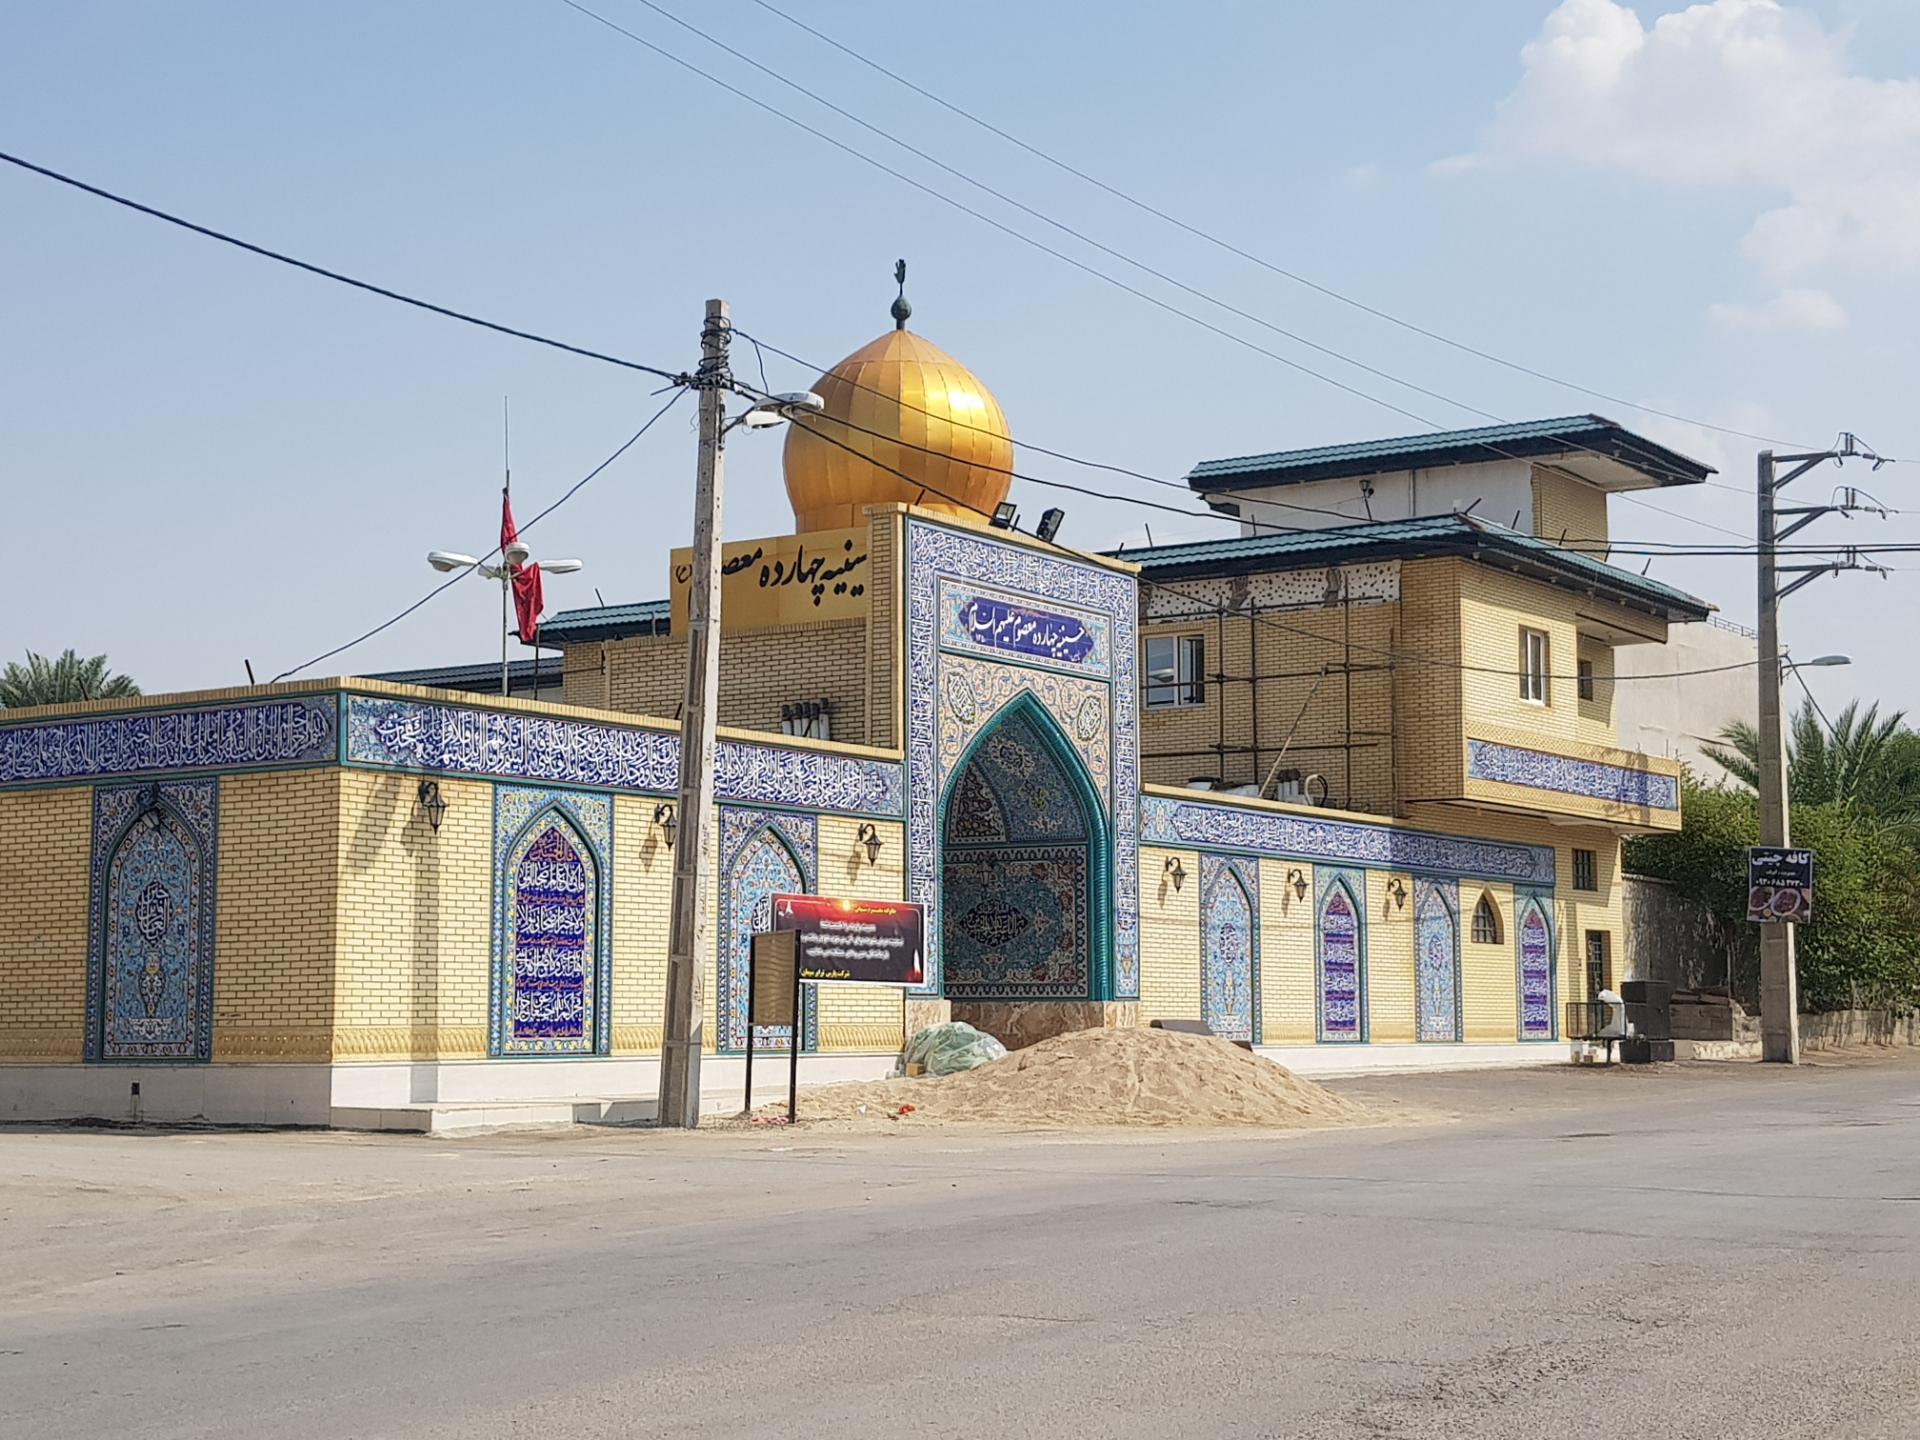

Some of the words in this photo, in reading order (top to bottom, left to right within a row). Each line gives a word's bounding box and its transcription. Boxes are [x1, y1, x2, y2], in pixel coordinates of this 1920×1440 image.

[759, 543, 826, 607] چهارده
[819, 539, 867, 598] ینیه
[968, 602, 996, 636] السلام
[994, 609, 1015, 649] علیهم
[1012, 615, 1037, 648] معصوم
[1032, 623, 1058, 657] چهارده
[1056, 625, 1085, 657] حسینیه
[1785, 850, 1810, 865] کافه
